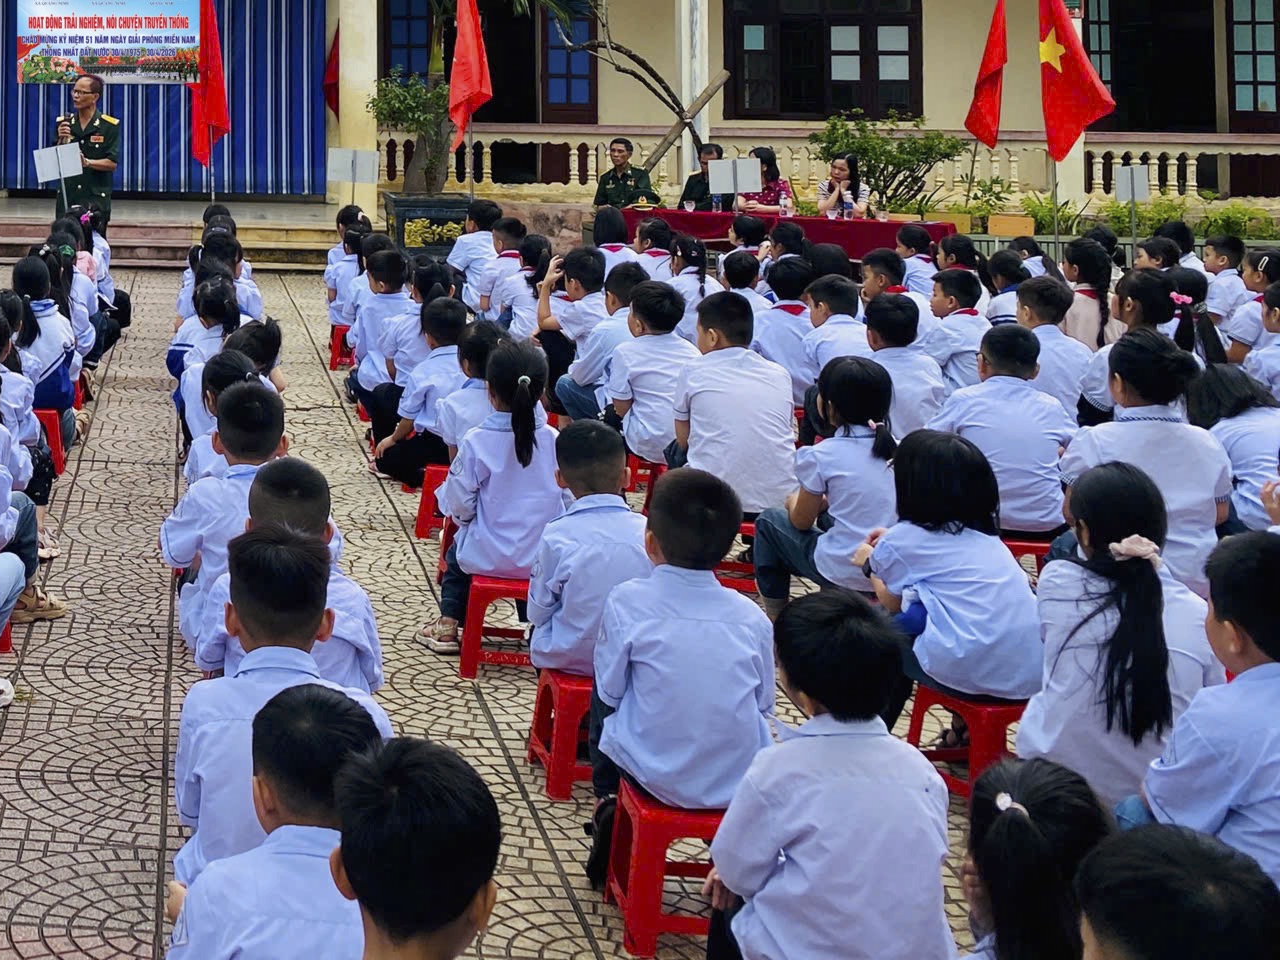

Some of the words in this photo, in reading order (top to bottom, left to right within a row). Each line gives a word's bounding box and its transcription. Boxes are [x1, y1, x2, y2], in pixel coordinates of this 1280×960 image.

[28, 16, 44, 31] HOẠT
[45, 14, 63, 31] ĐỘNG
[63, 13, 77, 29] TRẢI
[79, 14, 105, 31] NGHIỆM,
[106, 14, 117, 29] NÓI
[119, 14, 142, 31] CHUYỆN
[68, 34, 84, 45] NIỆM
[85, 36, 93, 44] 51
[94, 34, 109, 44] NĂM
[110, 34, 127, 44] NGÀY
[128, 33, 140, 44] GIẢI
[142, 34, 163, 44] PHÓNG
[182, 36, 196, 44] NAM
